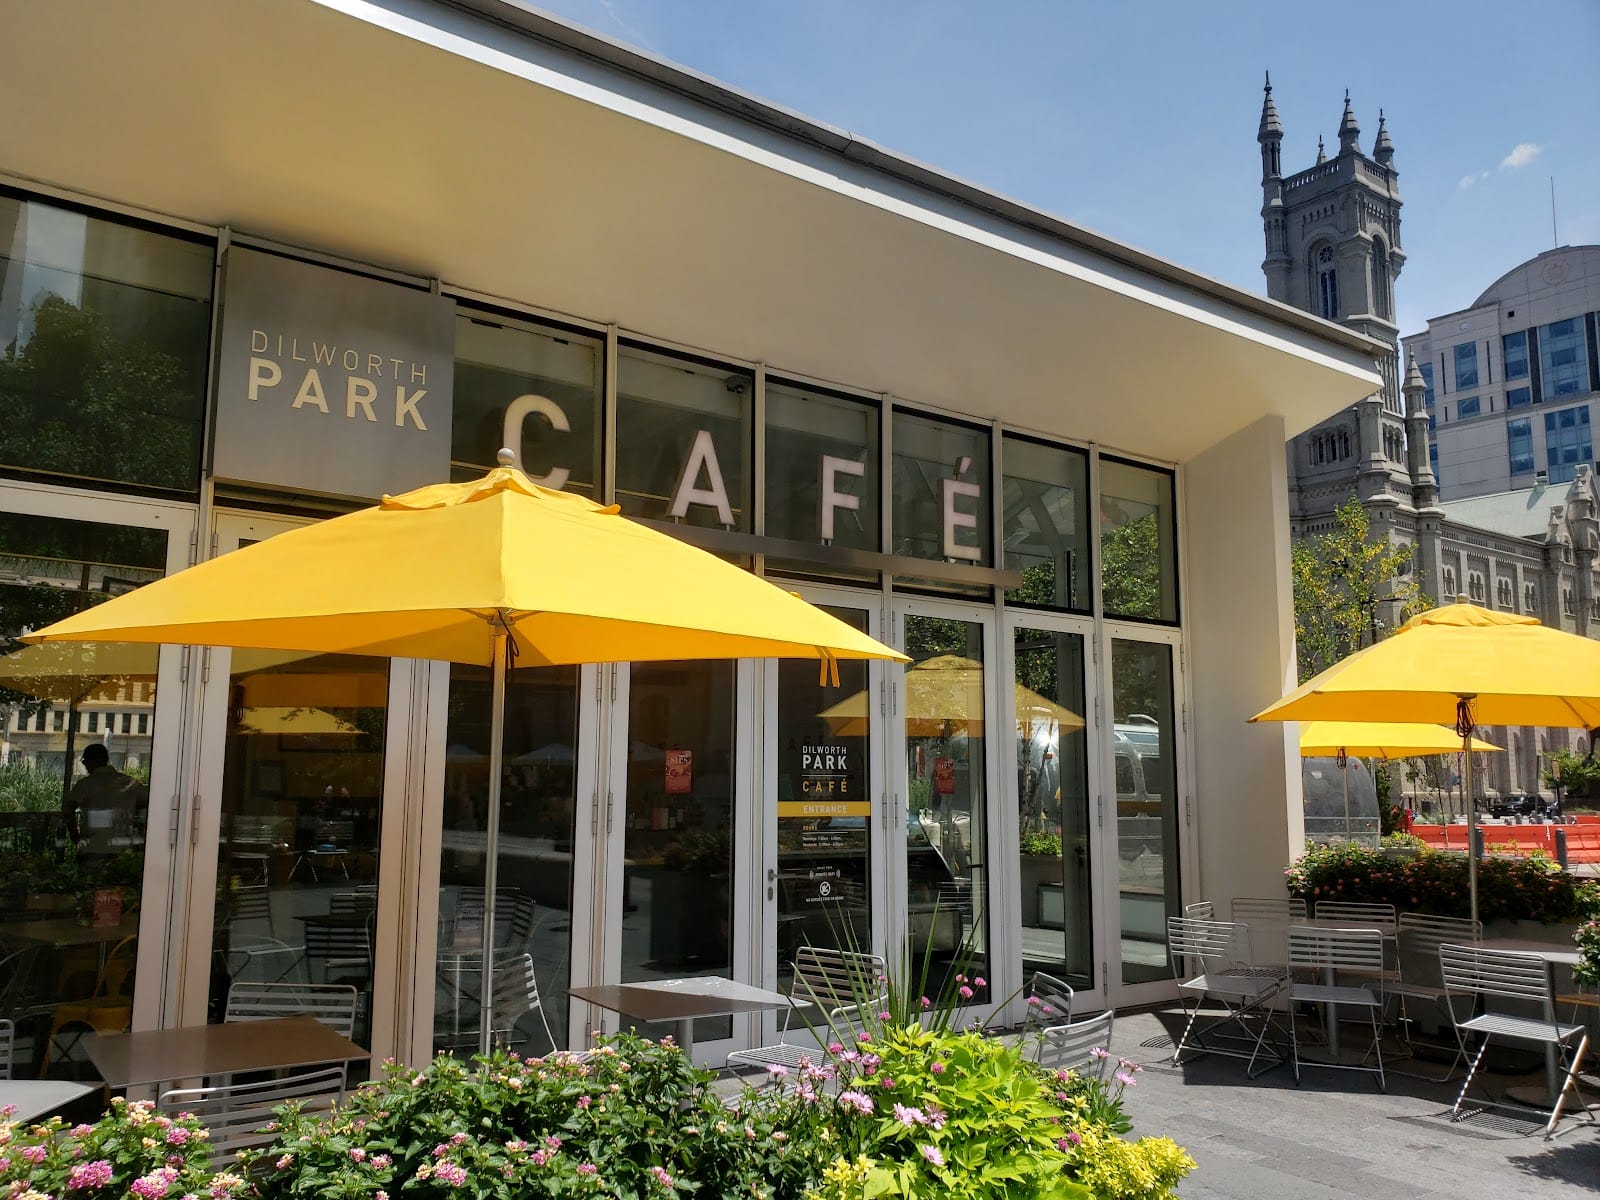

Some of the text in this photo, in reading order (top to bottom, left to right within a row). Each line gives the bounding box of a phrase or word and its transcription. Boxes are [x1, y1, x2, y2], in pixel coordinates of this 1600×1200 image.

[252, 330, 427, 385] DILWORTH
[247, 356, 428, 431] PARK
[503, 394, 982, 561] CAFÉ
[802, 745, 847, 755] DILWORTH
[802, 755, 848, 770] PARK
[802, 779, 848, 793] CAFÉ
[802, 805, 847, 814] ENTRANCE
